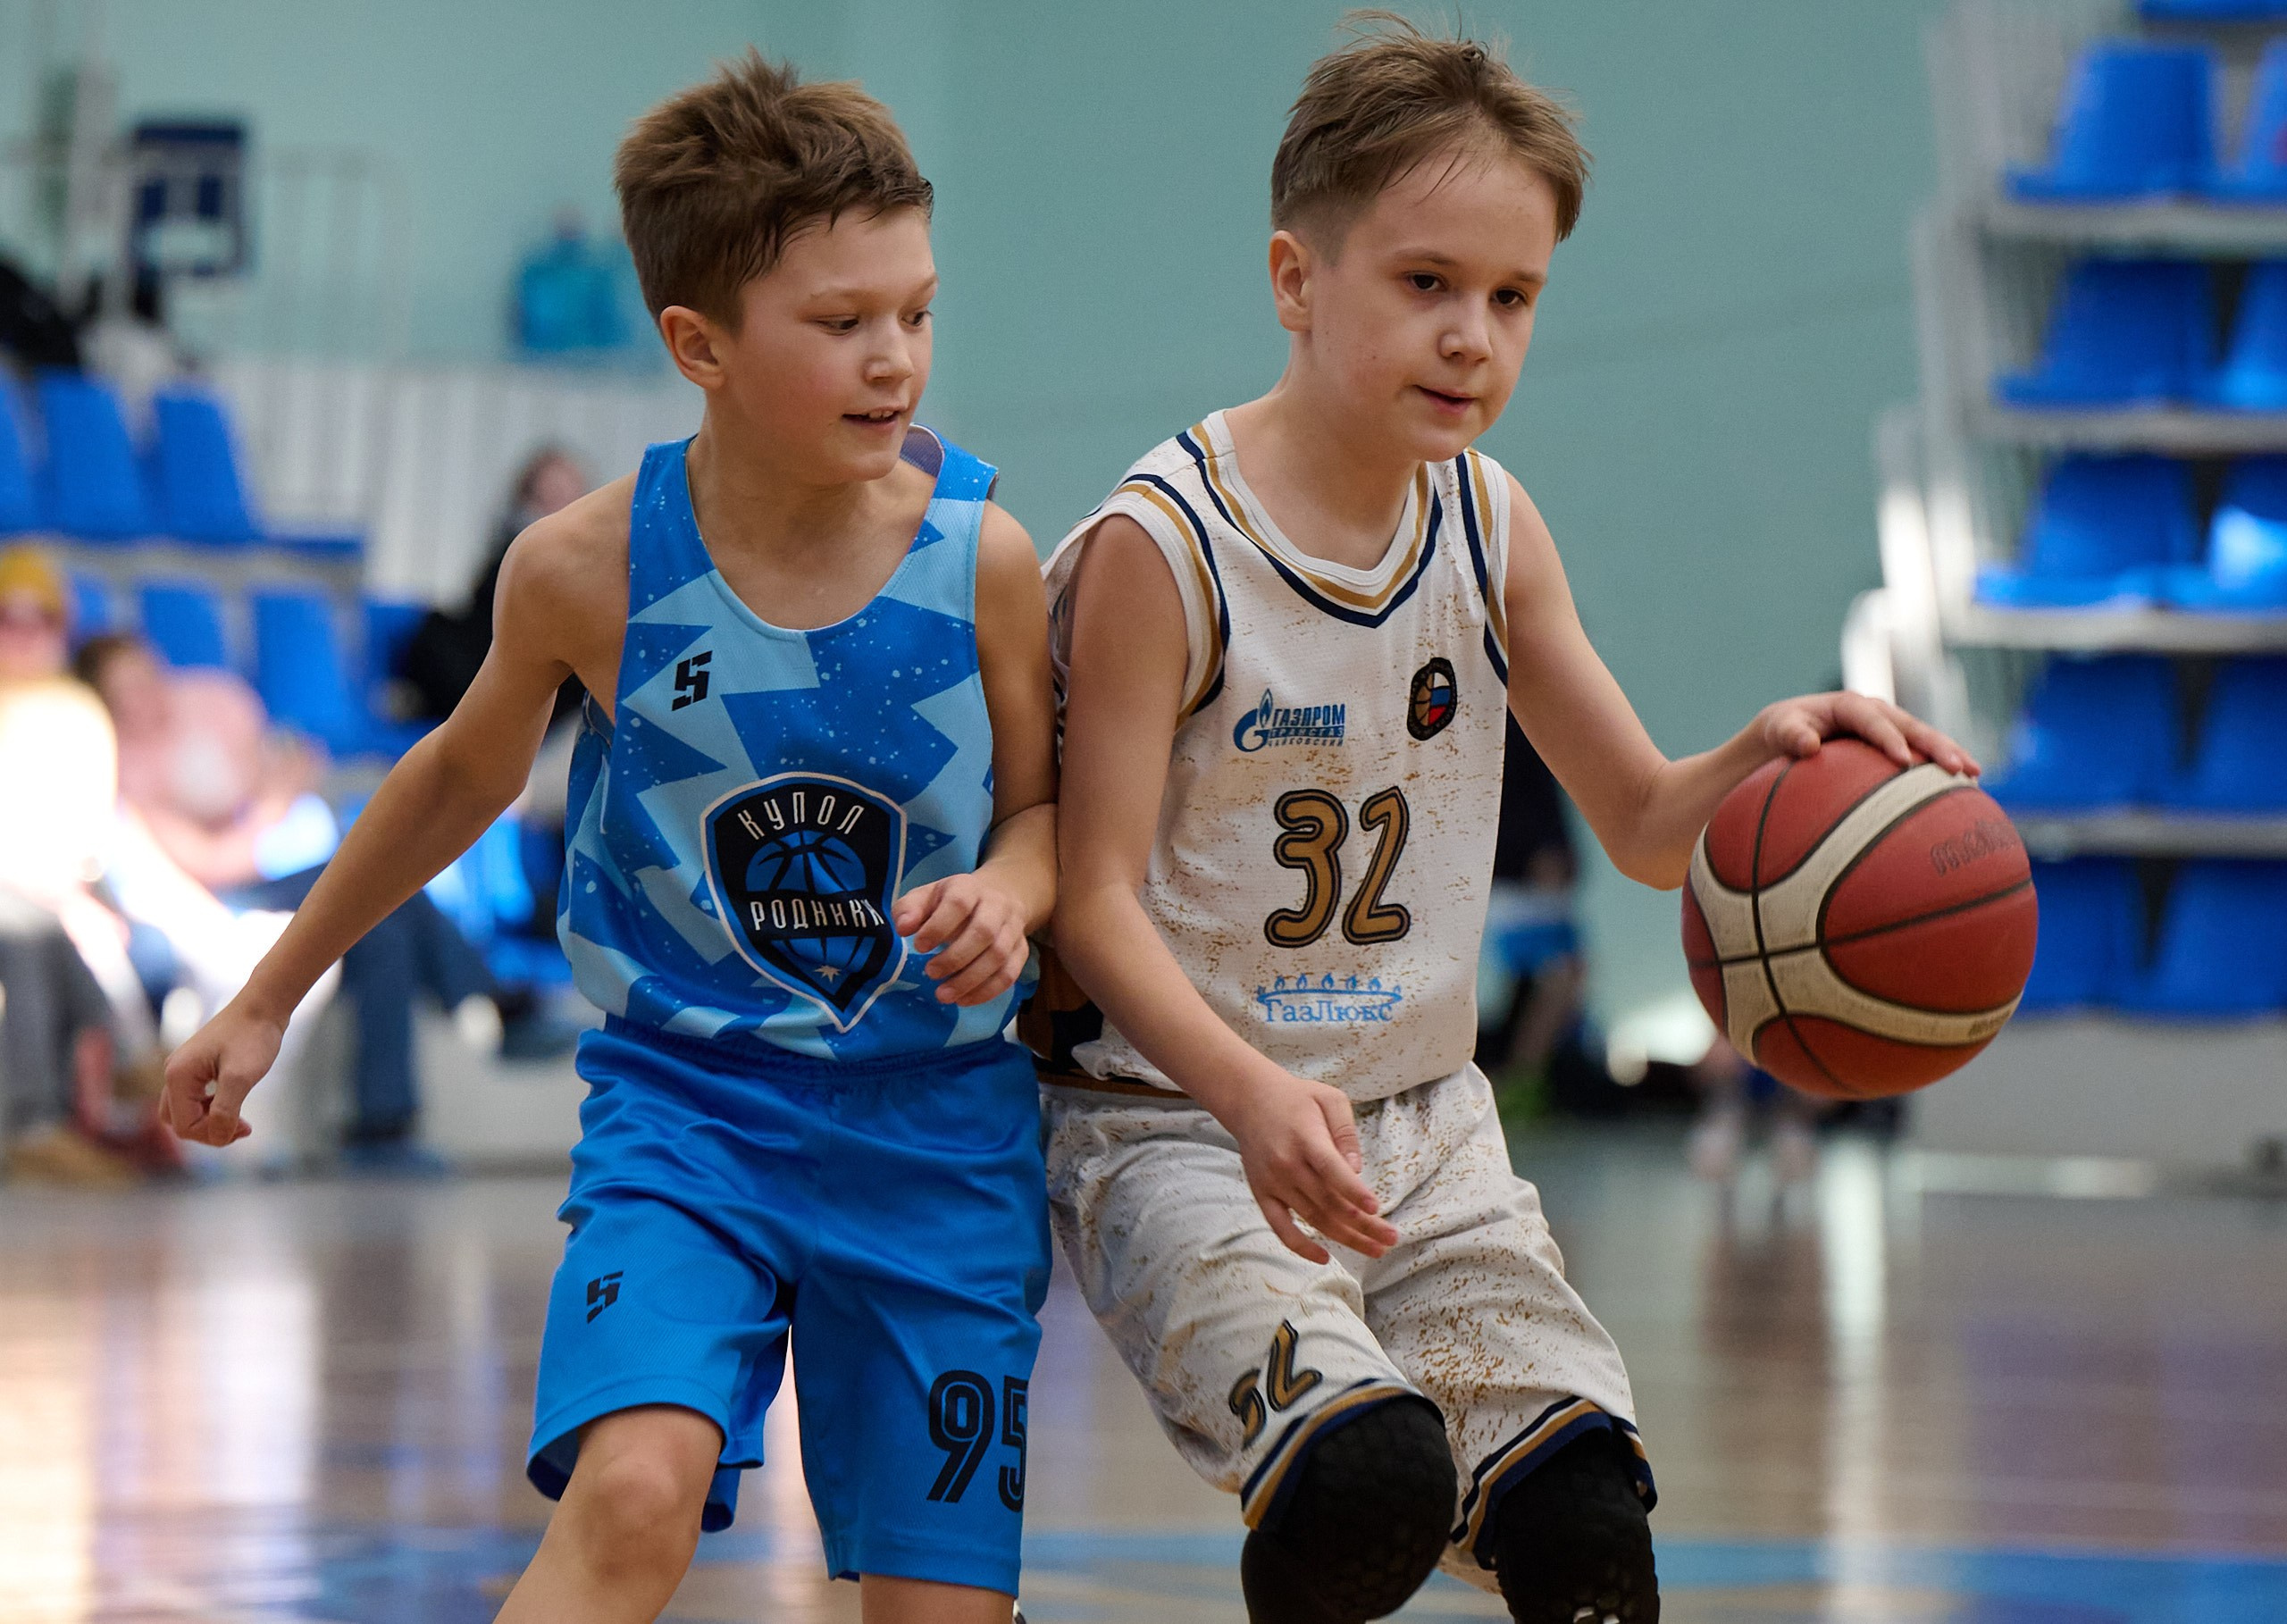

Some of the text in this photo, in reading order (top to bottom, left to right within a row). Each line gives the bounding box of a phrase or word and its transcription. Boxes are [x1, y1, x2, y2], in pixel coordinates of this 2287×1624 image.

[1272, 704, 1345, 727] ГАЗПРОМ
[737, 791, 865, 841] КУПОЛ
[1264, 786, 1411, 949] 32
[1265, 999, 1394, 1022] ГазЛюкс
[926, 1369, 1028, 1512] 95
